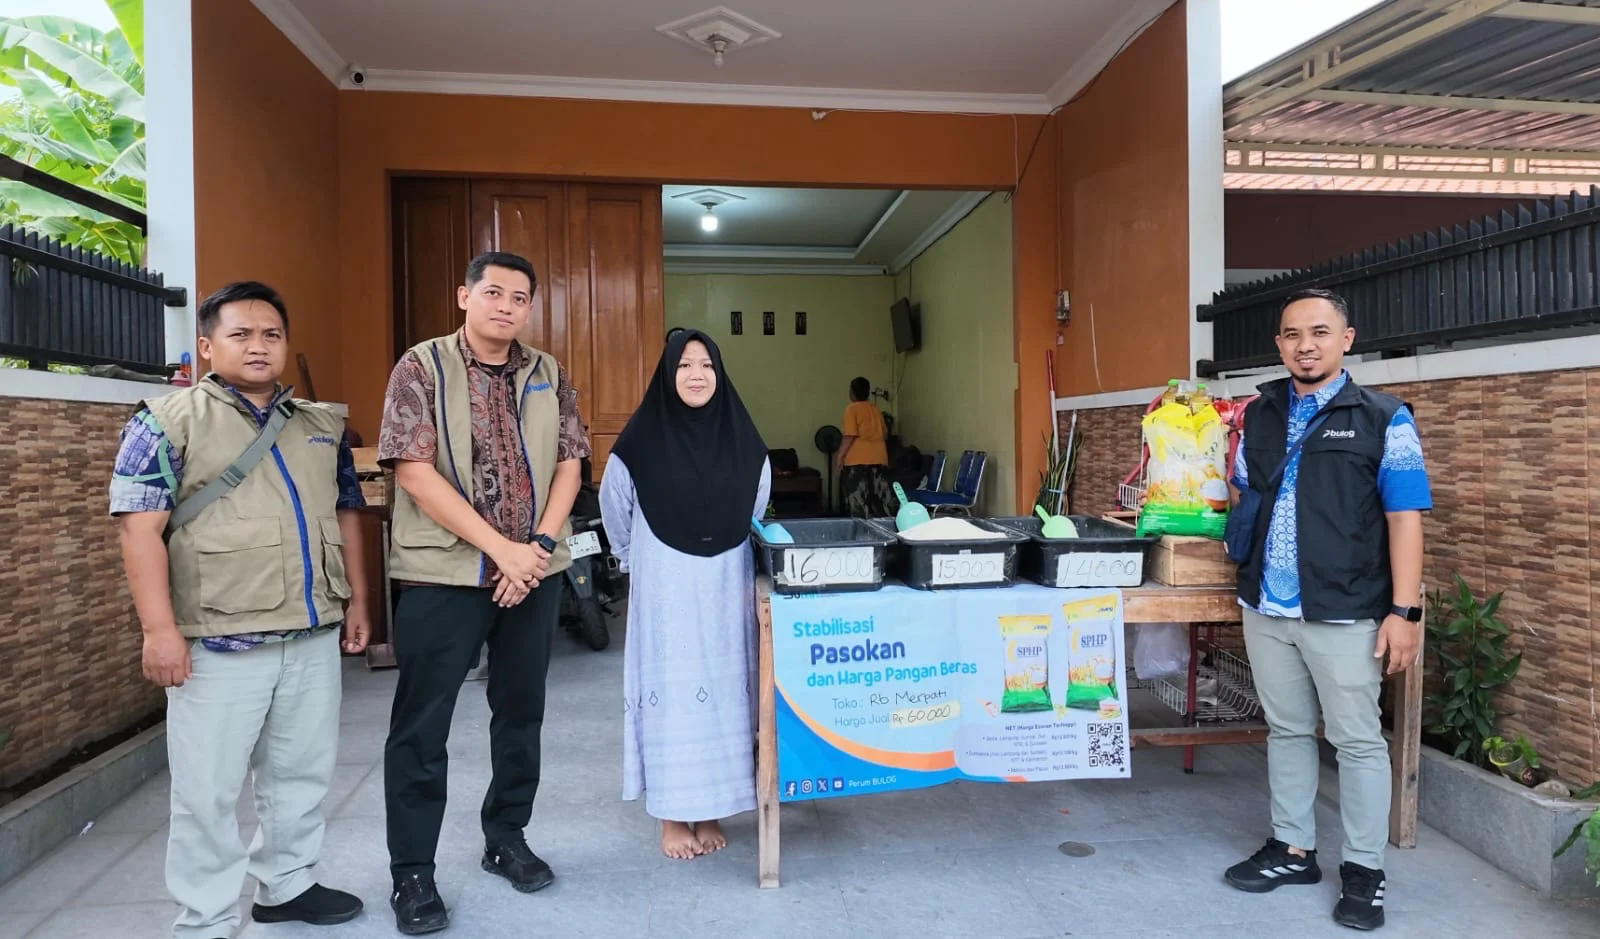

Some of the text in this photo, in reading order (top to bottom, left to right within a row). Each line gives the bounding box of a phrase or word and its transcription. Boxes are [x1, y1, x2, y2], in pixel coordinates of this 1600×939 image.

[1330, 430, 1356, 438] bulog
[937, 558, 996, 580] 15000
[1060, 559, 1137, 583] 14000
[793, 616, 875, 638] Stabilisasi
[1081, 634, 1107, 648] SPHP
[810, 638, 906, 666] Pasokan
[1017, 646, 1042, 657] SPHP
[807, 661, 978, 687] dan Harga Pangan Beras
[895, 689, 948, 706] Merpati
[834, 716, 867, 729] Harga
[869, 714, 891, 725] Jual
[849, 776, 896, 788] Perum BULOG
